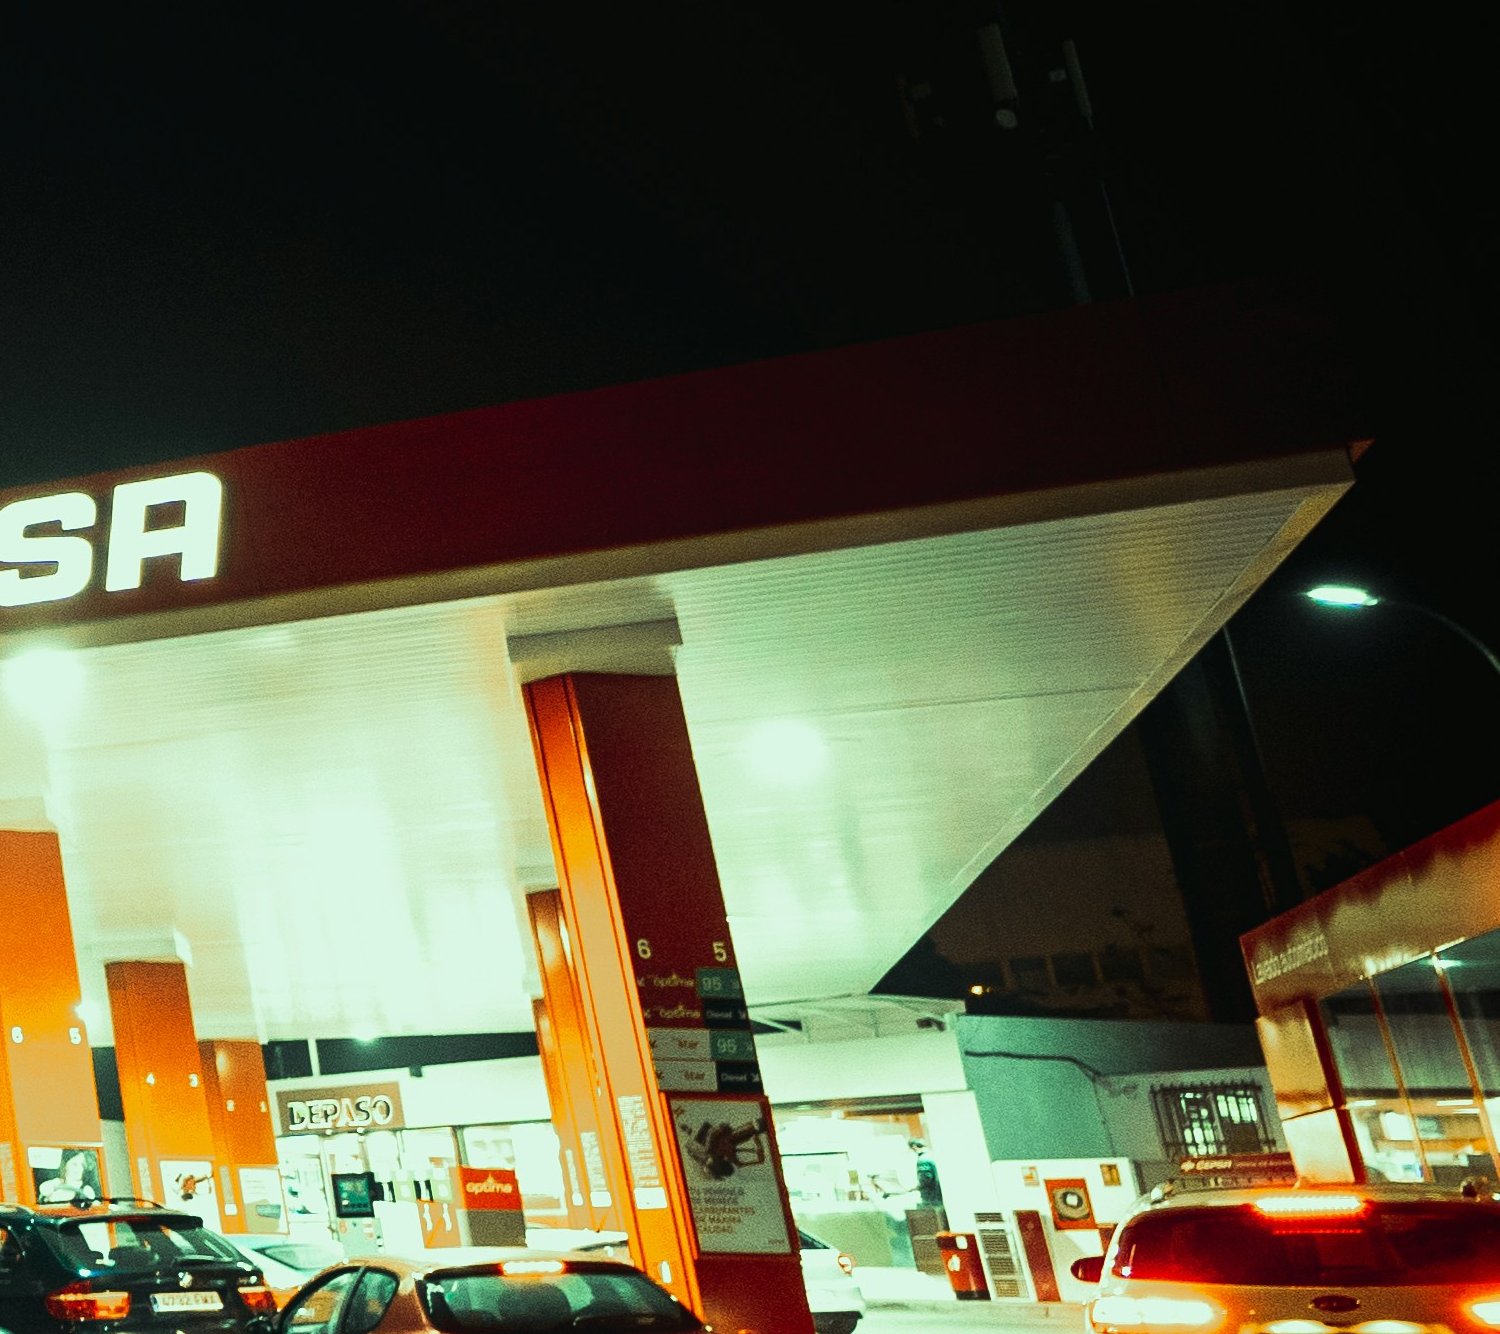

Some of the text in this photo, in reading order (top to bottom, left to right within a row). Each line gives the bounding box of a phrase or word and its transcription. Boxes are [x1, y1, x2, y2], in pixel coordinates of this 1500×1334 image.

[637, 939, 651, 959] 6
[713, 941, 727, 962] 5
[11, 1026, 24, 1044] 6
[288, 1095, 393, 1130] DEPASO
[466, 1180, 513, 1195] optima
